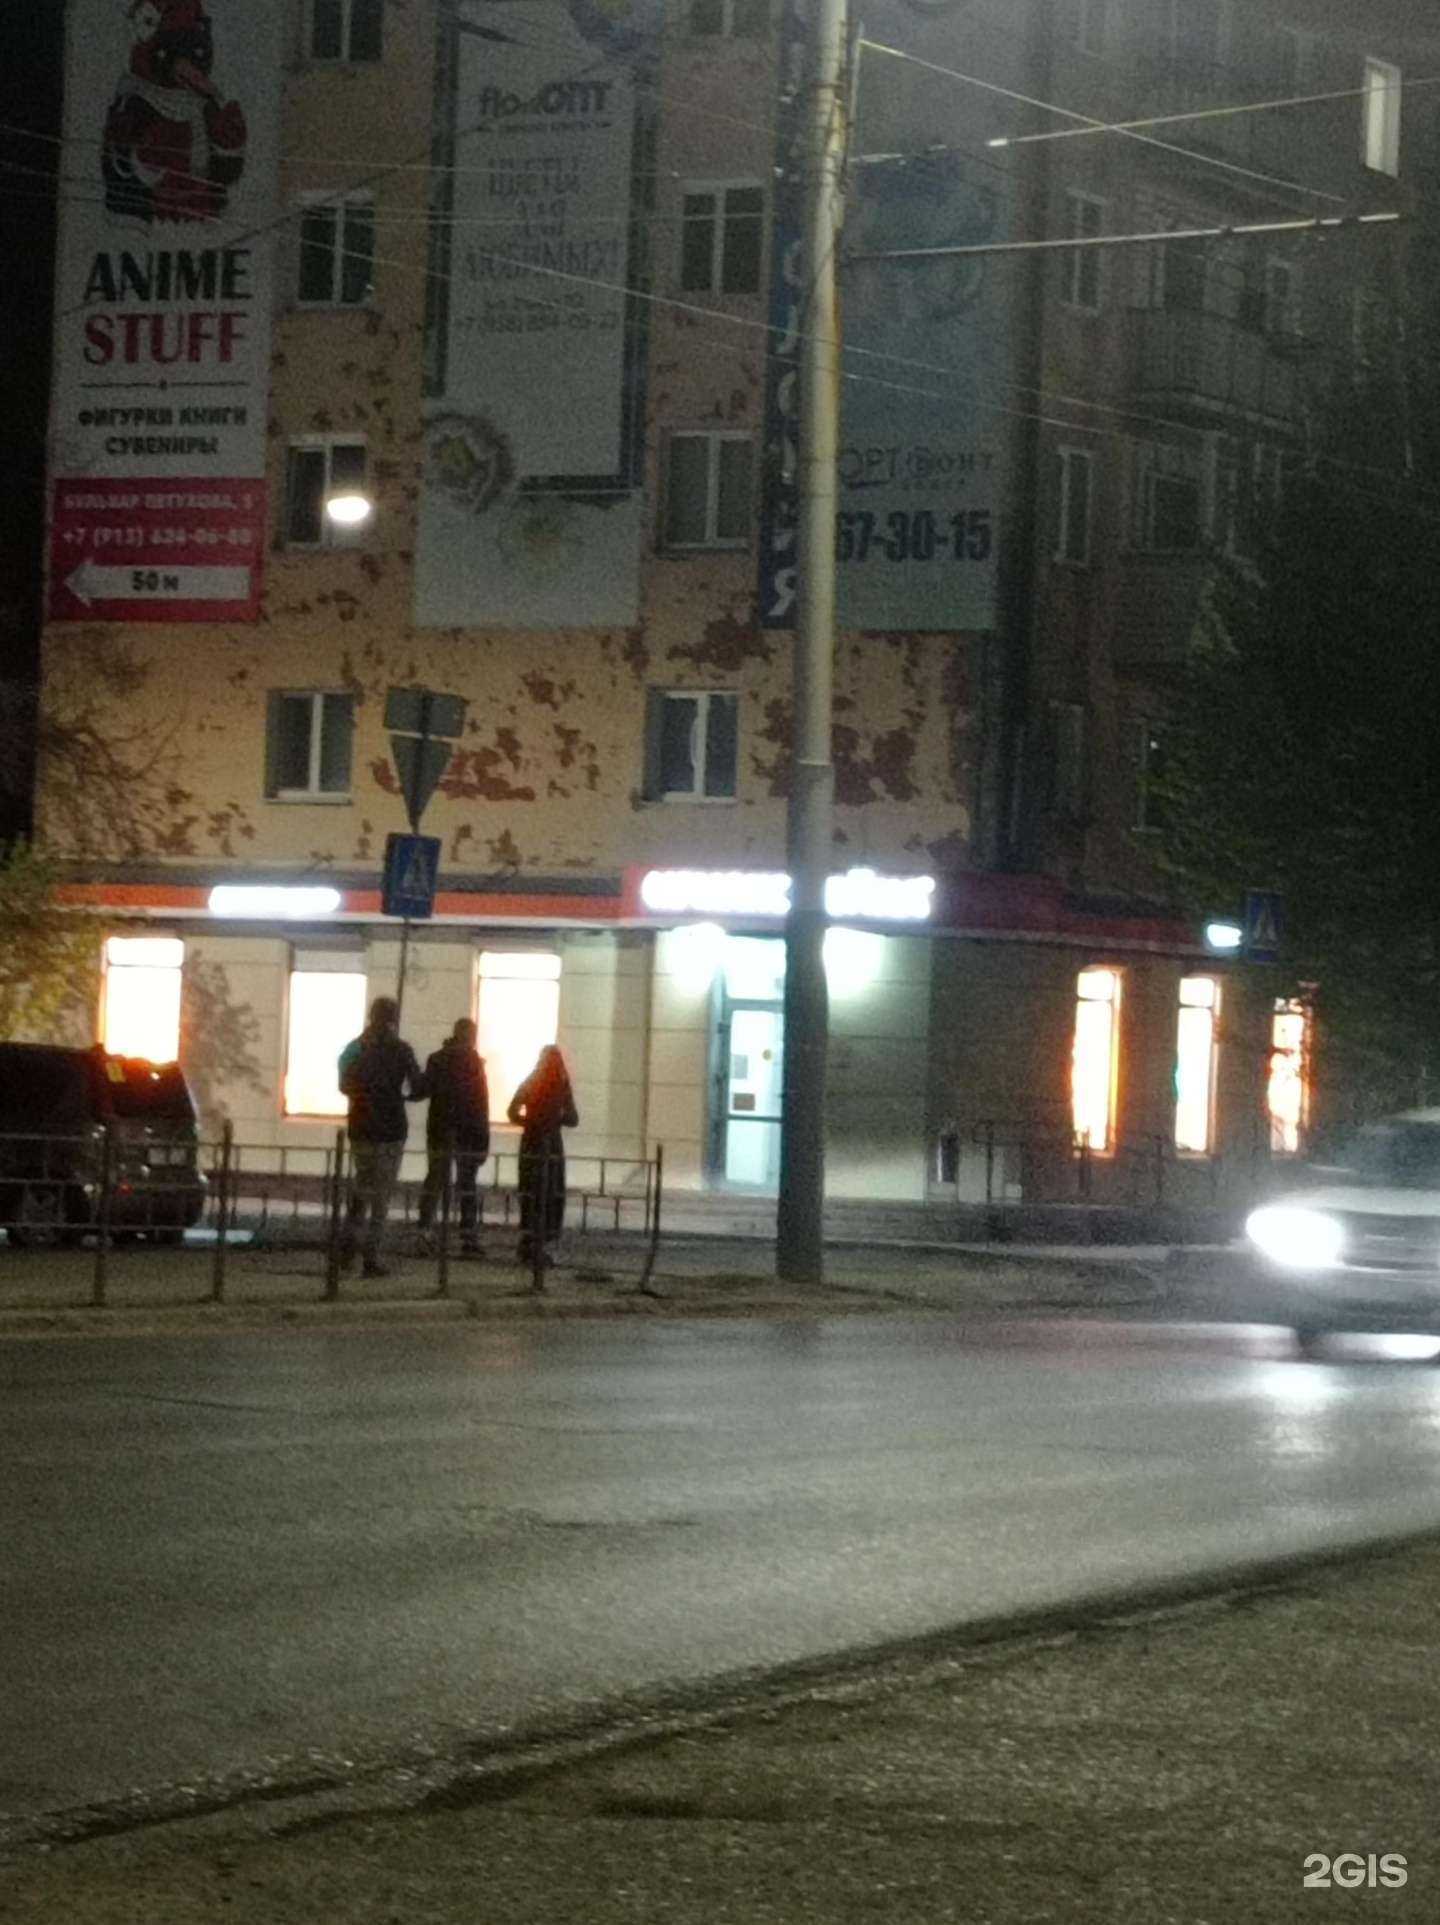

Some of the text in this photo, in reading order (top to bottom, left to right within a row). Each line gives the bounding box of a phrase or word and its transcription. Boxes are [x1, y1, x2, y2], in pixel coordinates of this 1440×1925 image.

[84, 249, 252, 303] ANIME
[83, 312, 249, 366] STUFF
[78, 405, 247, 427] ФИГУРКИ КНИГИ
[104, 435, 219, 455] СУВЕНИРЫ
[62, 527, 87, 545] +7
[132, 570, 159, 592] 50
